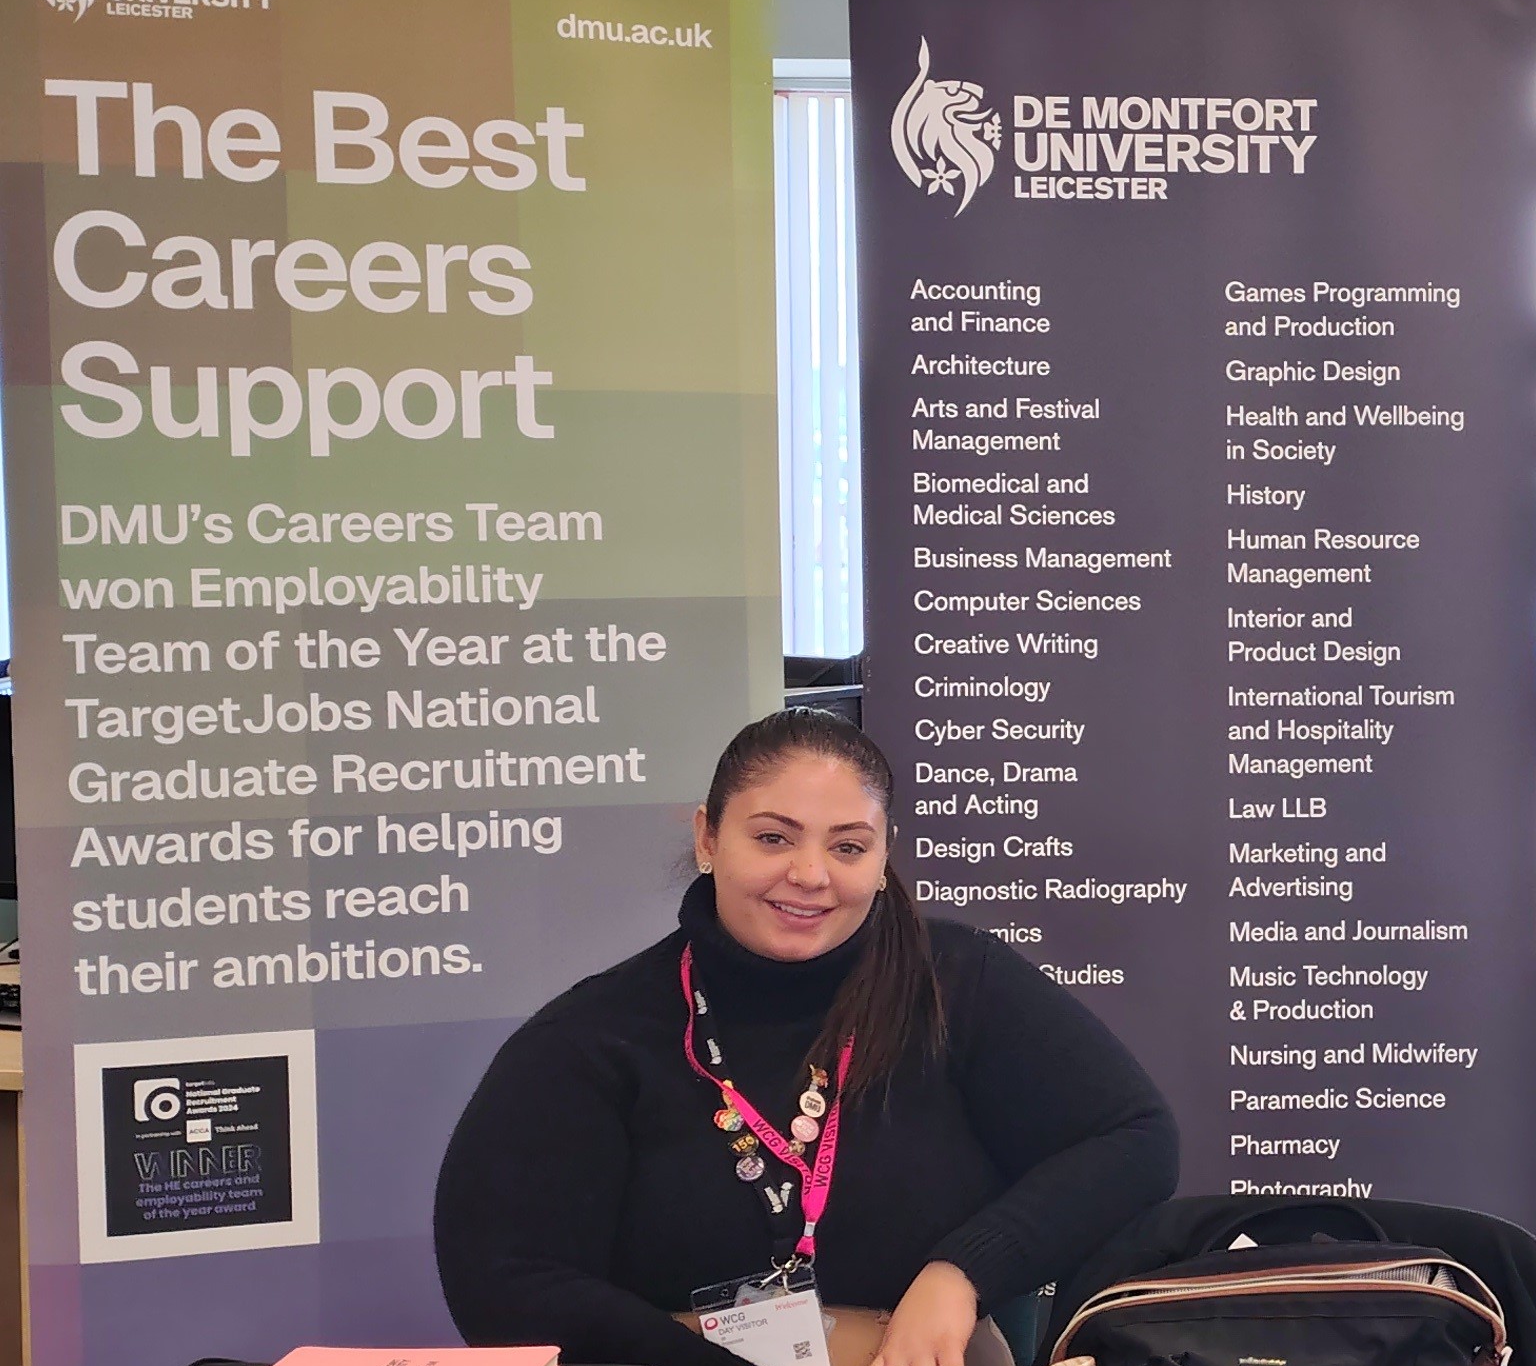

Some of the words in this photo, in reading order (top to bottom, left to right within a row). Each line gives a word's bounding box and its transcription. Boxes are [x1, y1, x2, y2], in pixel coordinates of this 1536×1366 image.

[107, 2, 192, 19] LEICESTER
[557, 14, 712, 47] dmu.ac.uk
[1014, 96, 1070, 128] DE
[1083, 97, 1317, 131] MONTFORT
[45, 79, 281, 182] The
[313, 91, 586, 191] Best
[1015, 132, 1317, 173] UNIVERSITY
[1015, 176, 1167, 199] LEICESTER
[54, 210, 533, 316] Careers
[911, 279, 1040, 306] Accounting
[1225, 281, 1305, 302] Games
[1314, 282, 1460, 308] Programming
[911, 311, 952, 331] and
[962, 311, 1050, 332] Finance
[1225, 316, 1266, 336] and
[1275, 316, 1394, 336] Production
[911, 354, 1050, 375] Architecture
[1226, 360, 1315, 386] Graphic
[1324, 360, 1400, 386] Design
[61, 341, 554, 457] Support
[914, 473, 1039, 493] Biomedical
[1047, 473, 1088, 493] and
[248, 504, 453, 543] Careers
[466, 504, 602, 541] Team
[914, 504, 1001, 525] Medical
[1010, 504, 1115, 525] Sciences
[61, 578, 173, 609] won
[191, 564, 544, 614] Employability
[63, 634, 210, 674] Team
[226, 631, 279, 670] of
[294, 630, 380, 668] the
[393, 628, 509, 666] Year
[524, 628, 573, 663] at
[585, 625, 666, 661] the
[65, 693, 371, 744] TargetJobs
[387, 686, 599, 729] National
[916, 719, 985, 745] Cyber
[992, 719, 1084, 744] Security
[69, 760, 317, 803] Graduate
[333, 748, 646, 793] Recruitment
[1230, 798, 1275, 818] Law
[1283, 798, 1326, 817] LLB
[71, 821, 273, 867] Awards
[288, 819, 362, 857] for
[378, 811, 562, 857] helping
[73, 886, 311, 932] students
[326, 875, 468, 918] reach
[917, 879, 1037, 906] Diagnostic
[1046, 878, 1187, 904] Radiography
[74, 952, 198, 995] their
[214, 940, 482, 988] ambitions.
[1231, 966, 1296, 986] Music
[1303, 965, 1428, 990] Technology
[1230, 1001, 1246, 1020] &
[1254, 999, 1373, 1019] Production
[732, 1136, 755, 1152] 150
[753, 1119, 779, 1147] WCG
[1231, 1135, 1340, 1159] Pharmacy
[134, 1144, 262, 1180] WINNER
[814, 1156, 832, 1188] WCG
[139, 1183, 162, 1193] The
[165, 1181, 181, 1191] HE
[183, 1177, 232, 1189] careers
[234, 1174, 260, 1184] and
[135, 1191, 226, 1208] employability
[227, 1188, 264, 1199] team
[143, 1210, 157, 1220] of
[160, 1208, 181, 1217] the
[181, 1206, 213, 1219] year
[214, 1201, 256, 1213] award
[719, 1311, 745, 1325] WCG
[774, 1299, 809, 1312] Welcome
[718, 1325, 735, 1336] DAY
[736, 1318, 769, 1332] VISITOR
